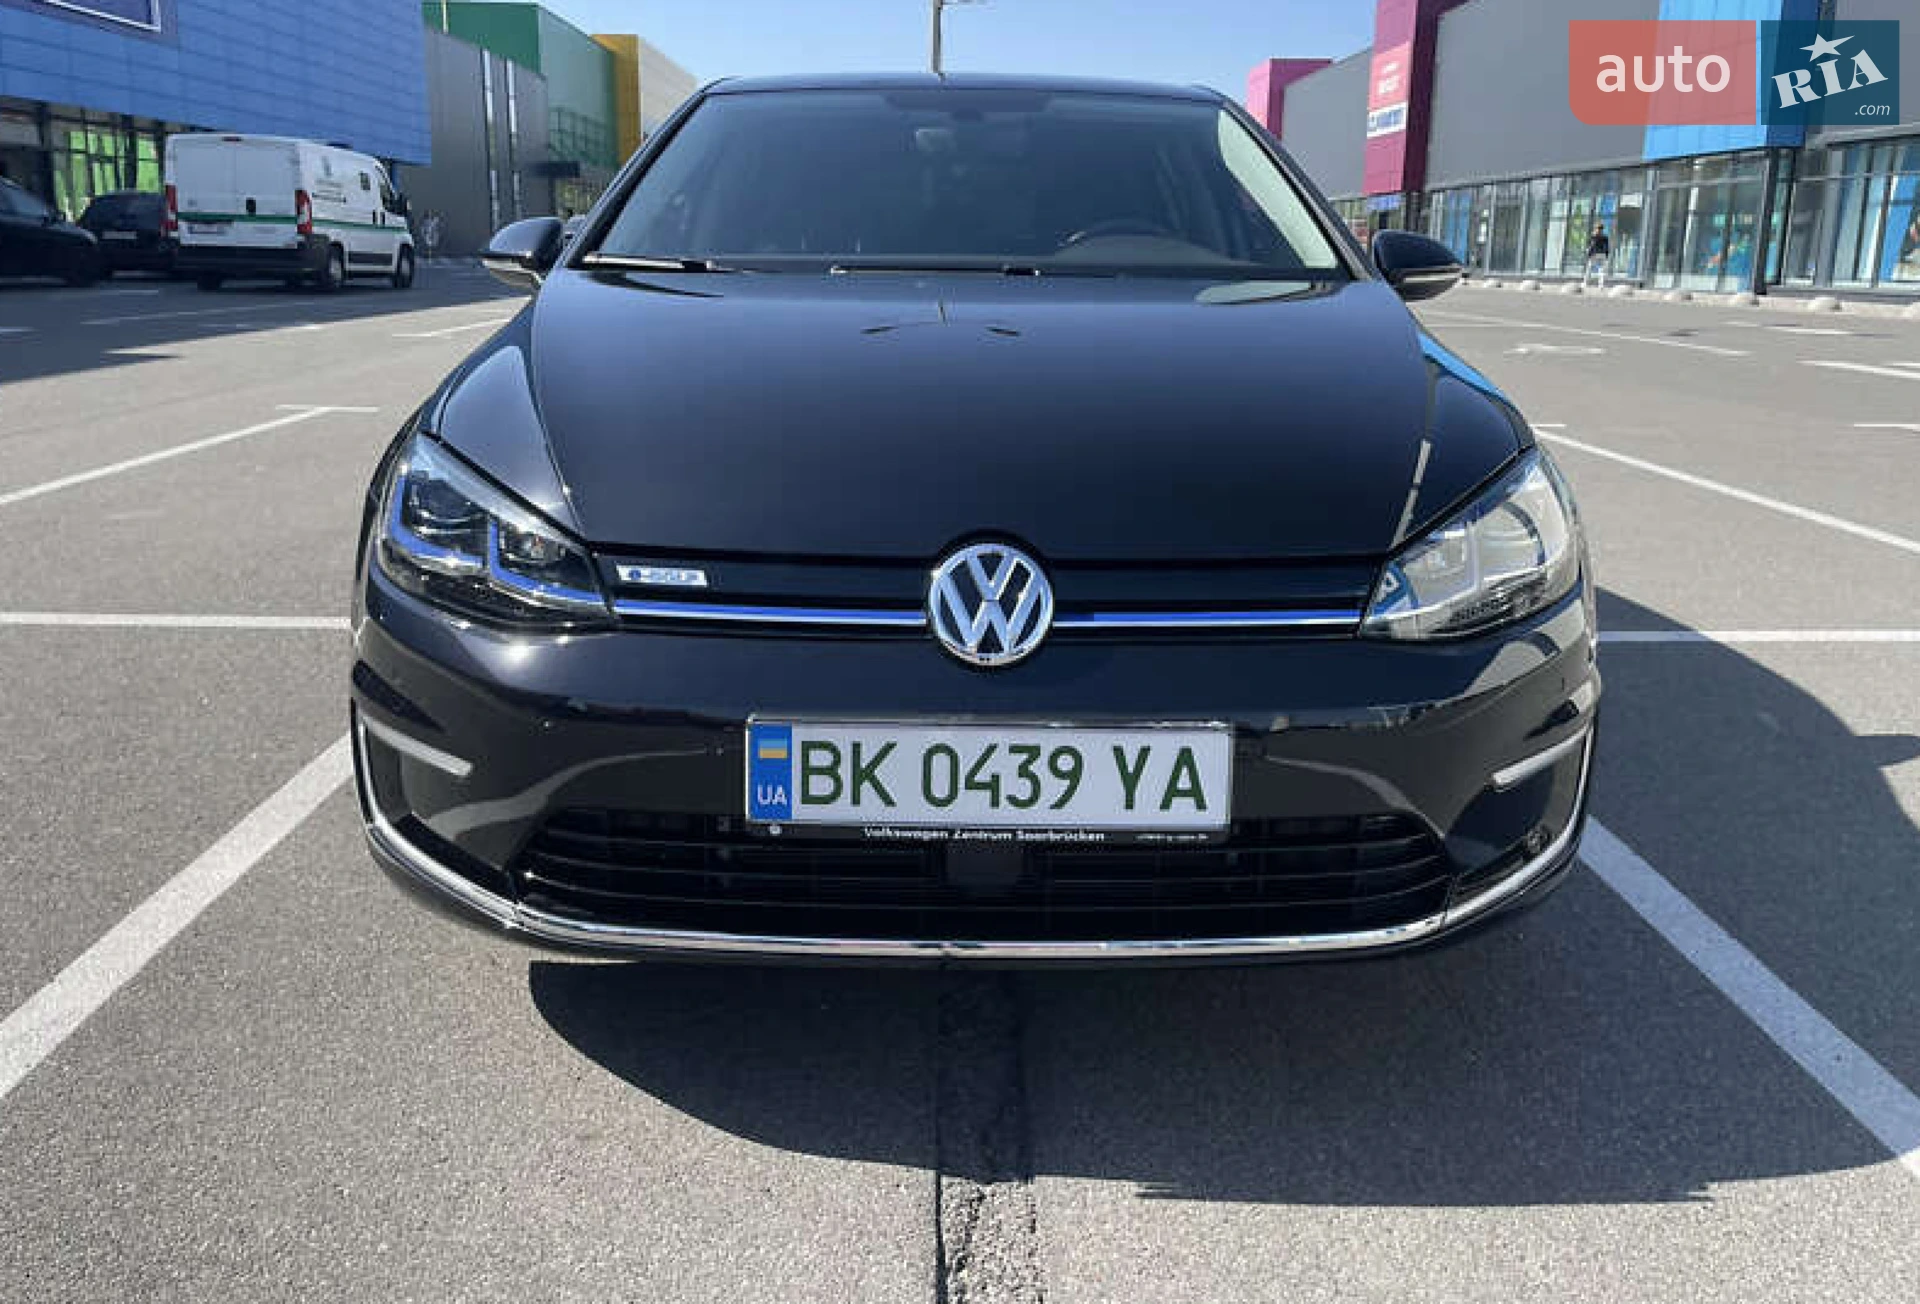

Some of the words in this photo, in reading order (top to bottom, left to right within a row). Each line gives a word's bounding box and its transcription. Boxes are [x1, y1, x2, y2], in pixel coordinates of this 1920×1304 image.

[757, 784, 787, 805] UA
[801, 740, 897, 807] BK
[921, 743, 1084, 810] 0439
[1112, 746, 1207, 811] YA
